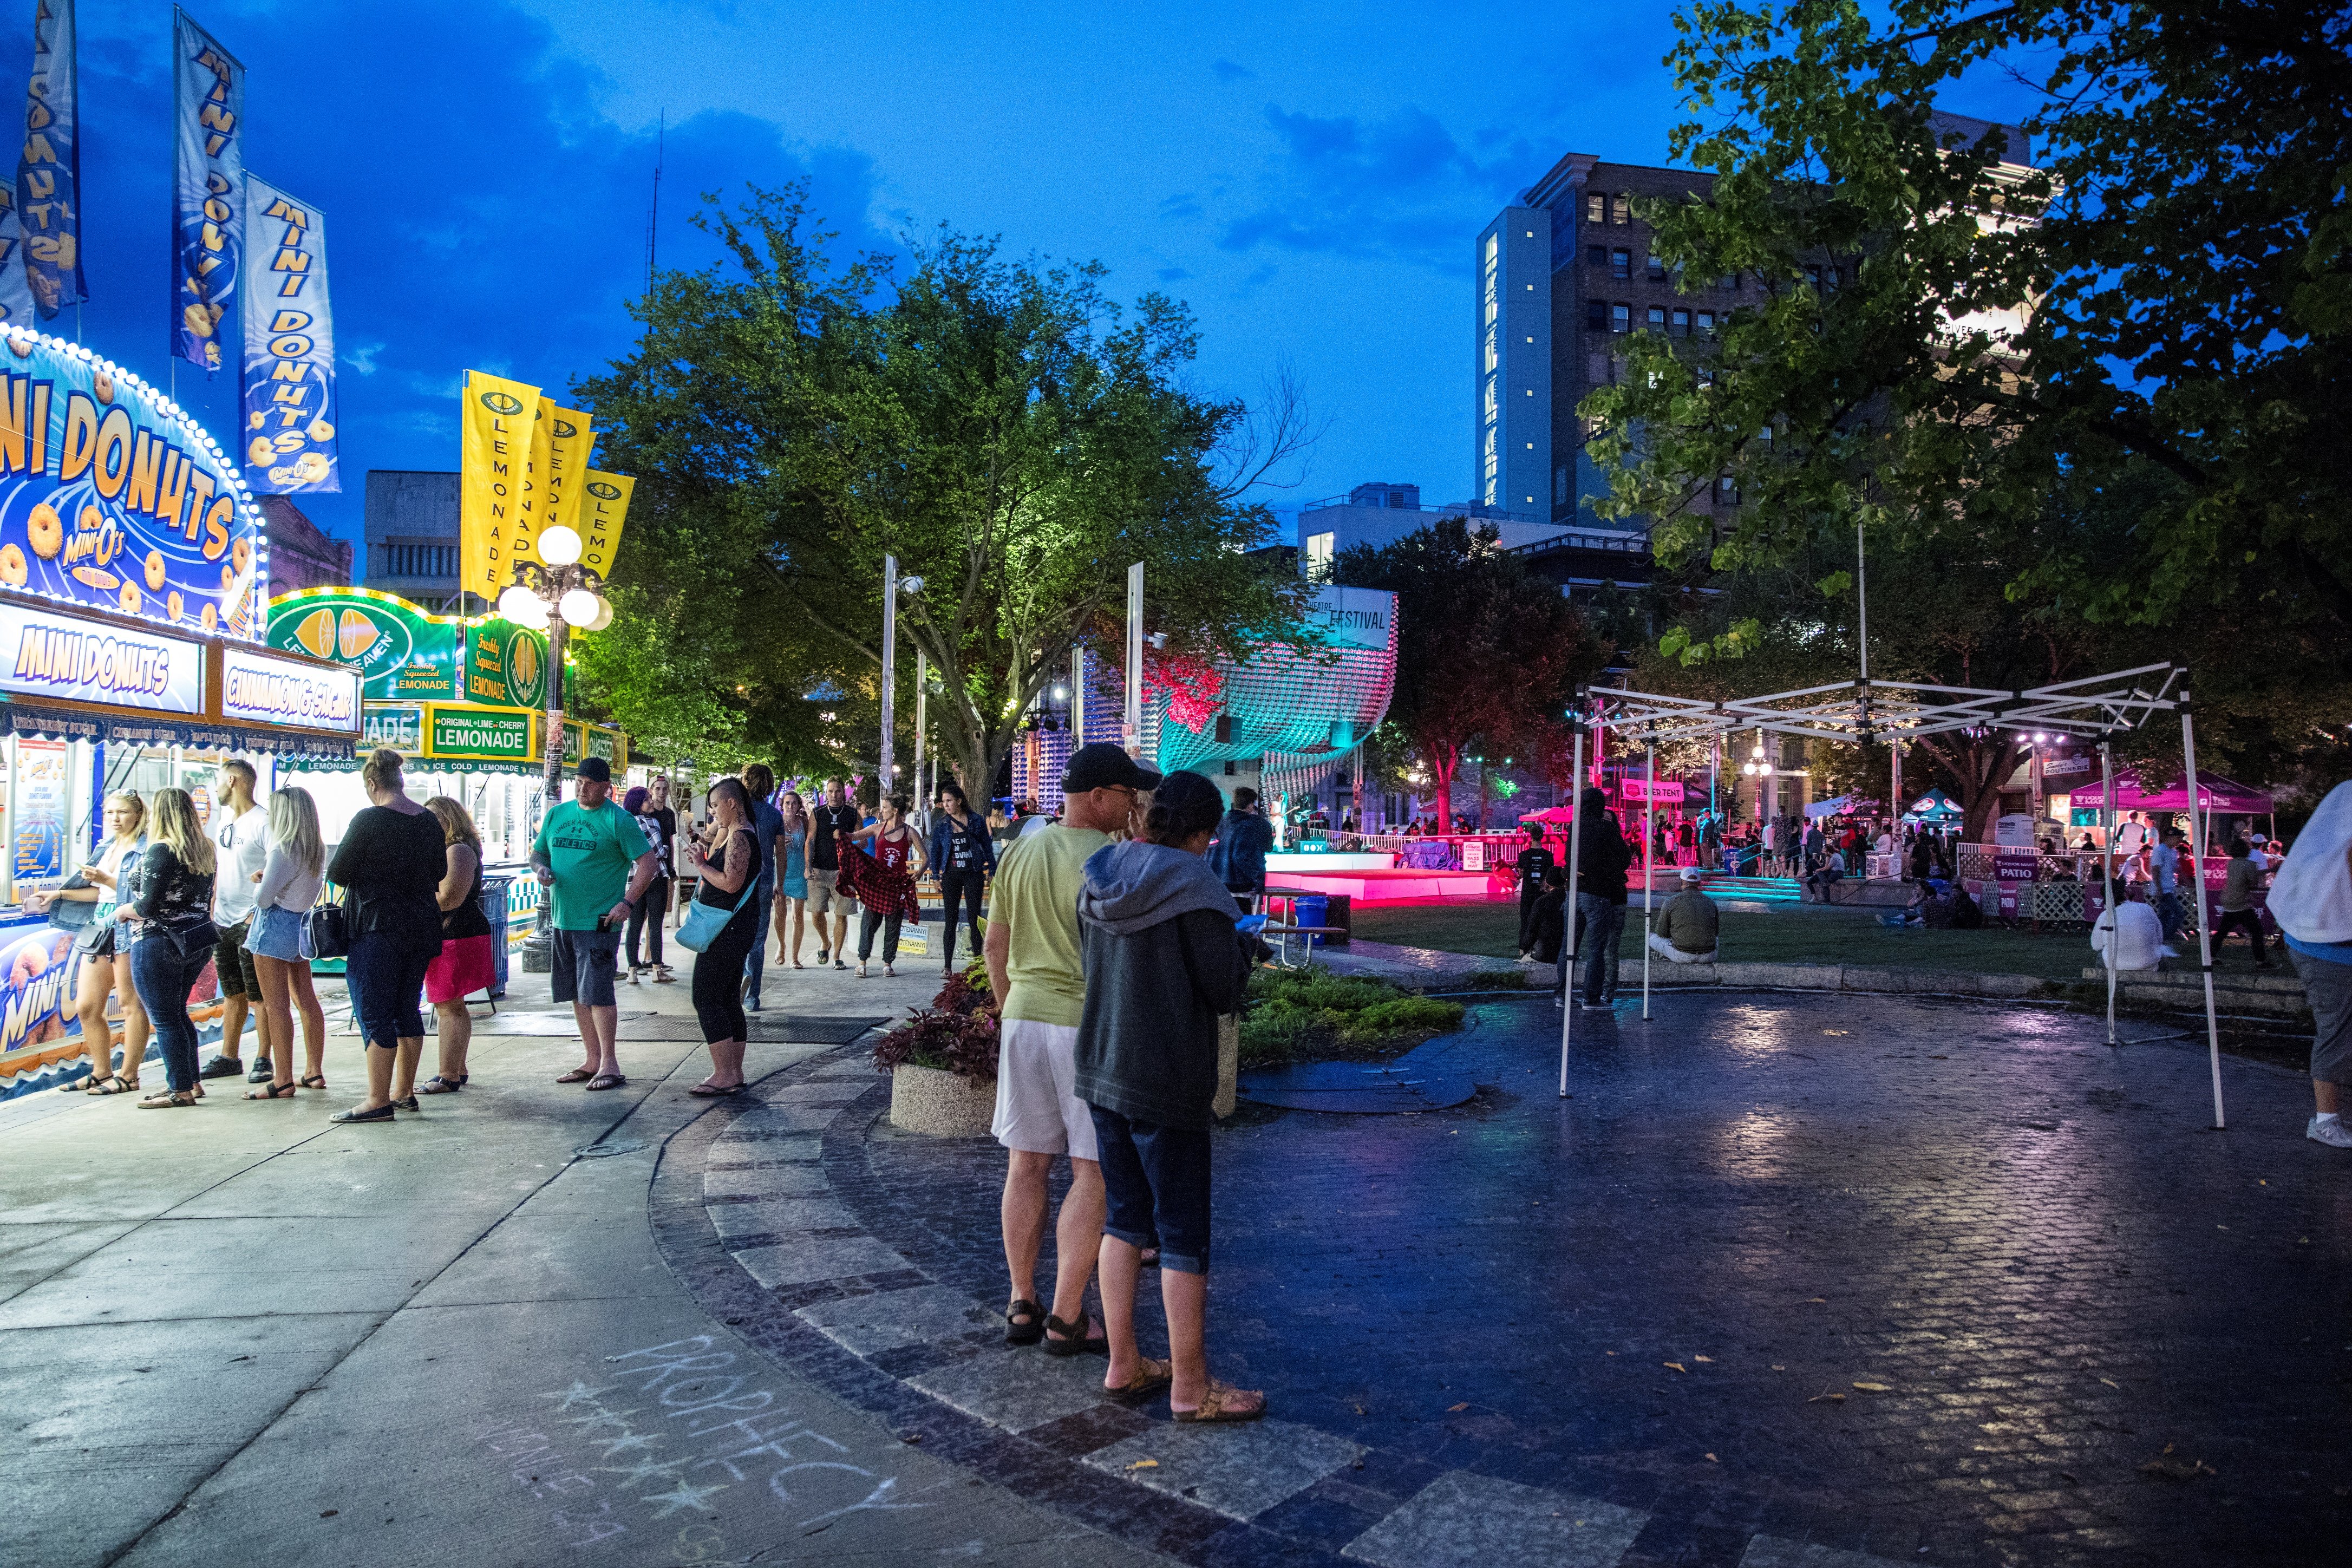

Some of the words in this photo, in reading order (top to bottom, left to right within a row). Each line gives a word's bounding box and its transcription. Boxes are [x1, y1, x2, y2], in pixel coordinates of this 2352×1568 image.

[190, 44, 233, 159] MINI
[262, 197, 310, 297] MINI
[266, 310, 314, 455] DONUTS
[486, 398, 500, 411] LEMON
[504, 404, 518, 413] HEAVEN
[60, 392, 236, 562] DONUTS
[548, 441, 564, 522] LEMON
[487, 418, 508, 583] LEMONADE
[591, 487, 602, 496] LEMON
[513, 462, 534, 570] MONADE
[62, 517, 125, 566] MINI-O'S
[587, 502, 609, 564] LEMO
[1330, 610, 1385, 629] FESTIVAL
[478, 633, 499, 658] Freshly
[13, 624, 83, 685] MINI
[82, 634, 169, 696] DONUTS
[407, 662, 436, 671] Freshly
[475, 651, 501, 672] Squeezed
[404, 669, 440, 678] Squeezed
[511, 661, 524, 698] LEMON
[527, 665, 540, 700] HEAVEN
[225, 666, 300, 716] CINNAMON
[300, 679, 312, 716] &
[313, 682, 351, 722] SUGAR
[394, 680, 449, 690] LEMONADE
[470, 674, 505, 701] LEMONADE
[441, 717, 473, 727] ORIGINAL
[478, 720, 493, 728] LIME
[499, 721, 525, 730] CHERRY
[436, 729, 524, 749] LEMONADE
[563, 730, 580, 755] SHLY
[590, 736, 613, 759] QUEEZED
[479, 764, 519, 772] LEMONADE
[2046, 765, 2089, 774] POUTINERIE
[1643, 787, 1661, 796] BER
[1662, 789, 1680, 798] TENT
[555, 819, 576, 834] UNDER
[577, 819, 598, 838] ARMOUR
[552, 838, 595, 850] ATHLETICS
[2001, 868, 2032, 878] PATIO
[2001, 898, 2015, 908] PATIO
[900, 926, 927, 935] OTENANNY!
[899, 939, 926, 949] OTENANNY!
